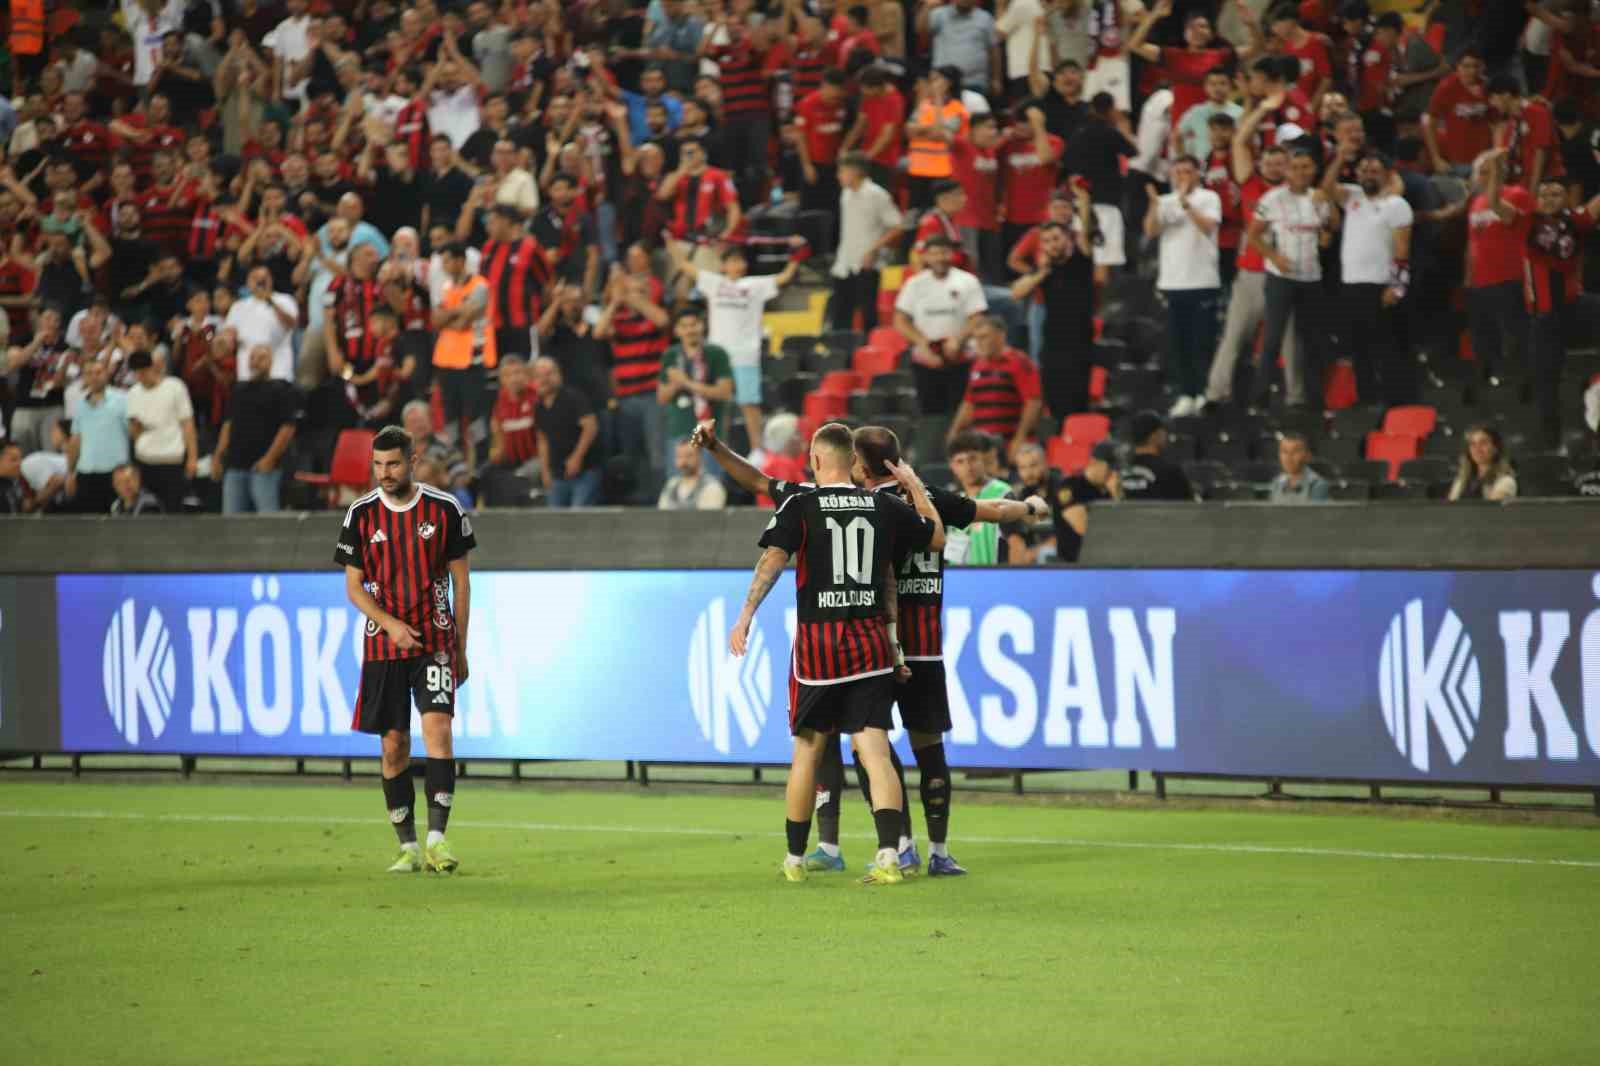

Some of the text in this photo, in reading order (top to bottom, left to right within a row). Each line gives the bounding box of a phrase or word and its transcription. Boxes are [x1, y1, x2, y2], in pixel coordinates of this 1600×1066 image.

[818, 494, 874, 508] KÖKSAN
[825, 516, 875, 584] 10
[187, 575, 520, 737] KÖKN
[427, 665, 452, 692] 96
